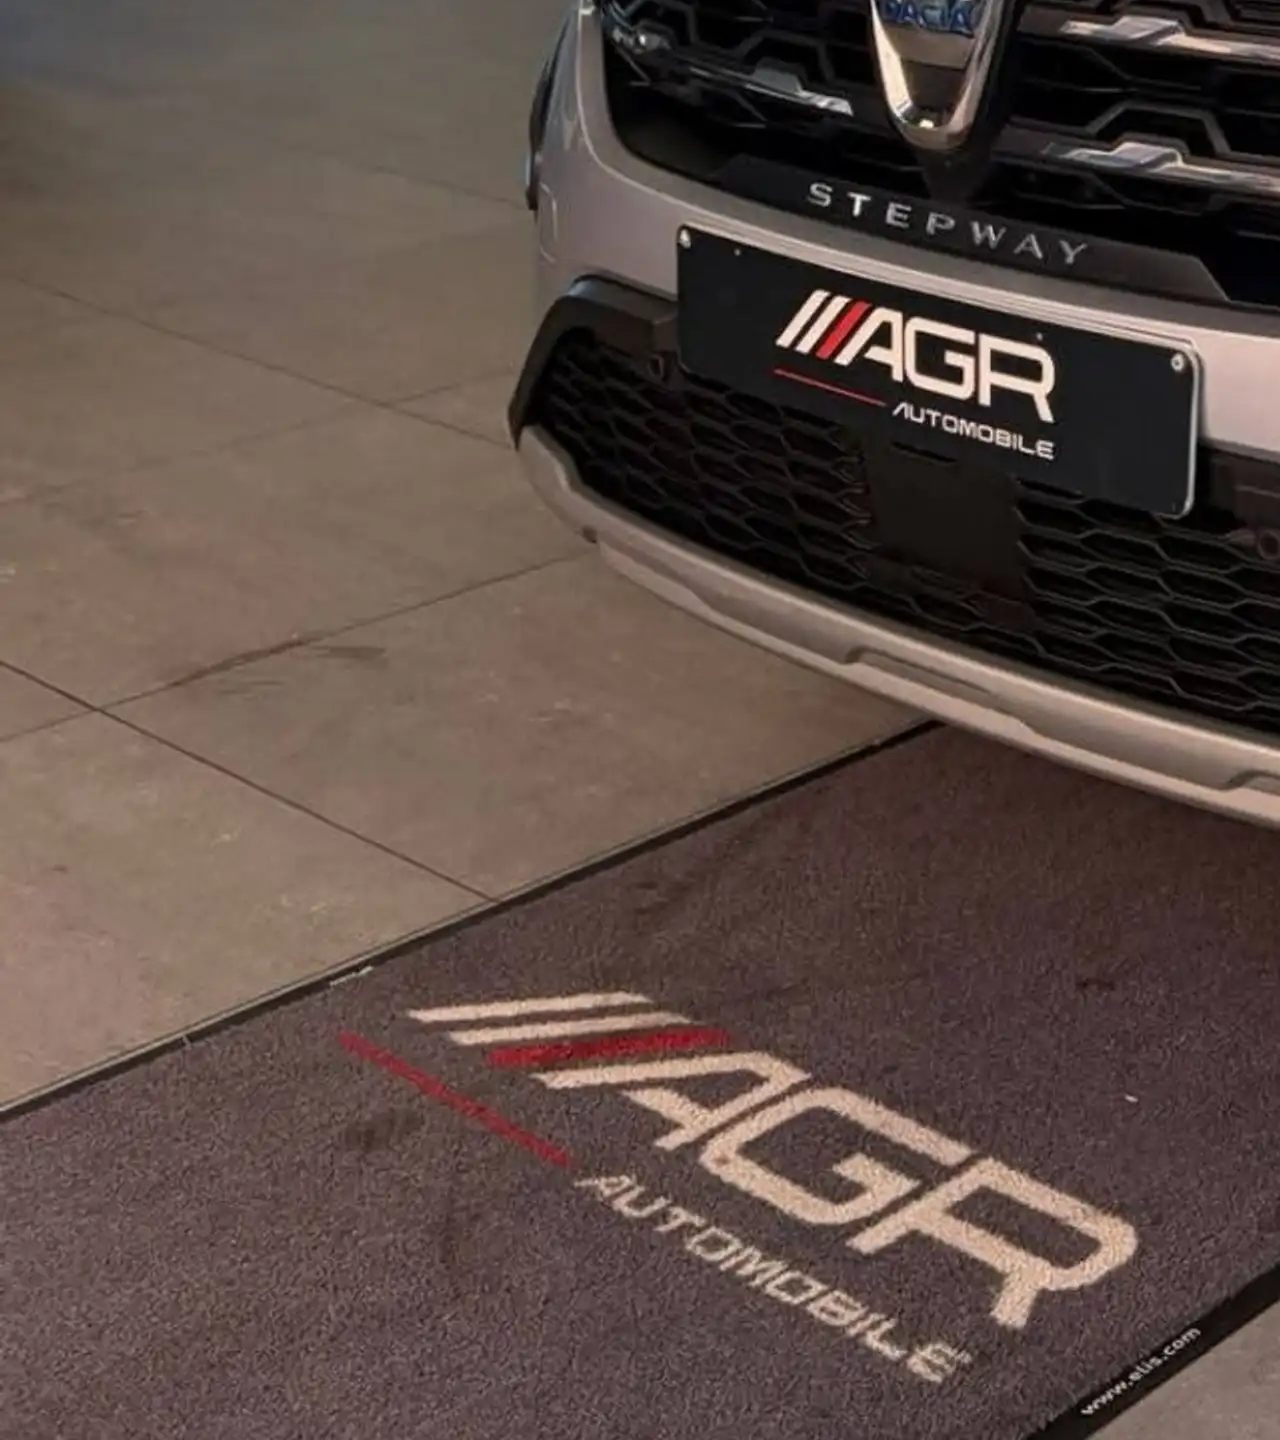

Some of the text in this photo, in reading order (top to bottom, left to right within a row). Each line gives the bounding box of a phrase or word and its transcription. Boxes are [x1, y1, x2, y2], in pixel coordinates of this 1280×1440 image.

[808, 181, 1089, 266] STEPWAY
[891, 401, 1056, 461] AUTOMOBILE
[573, 1169, 974, 1385] AUTOMOBILE
[1079, 1327, 1202, 1416] www.elis.com
